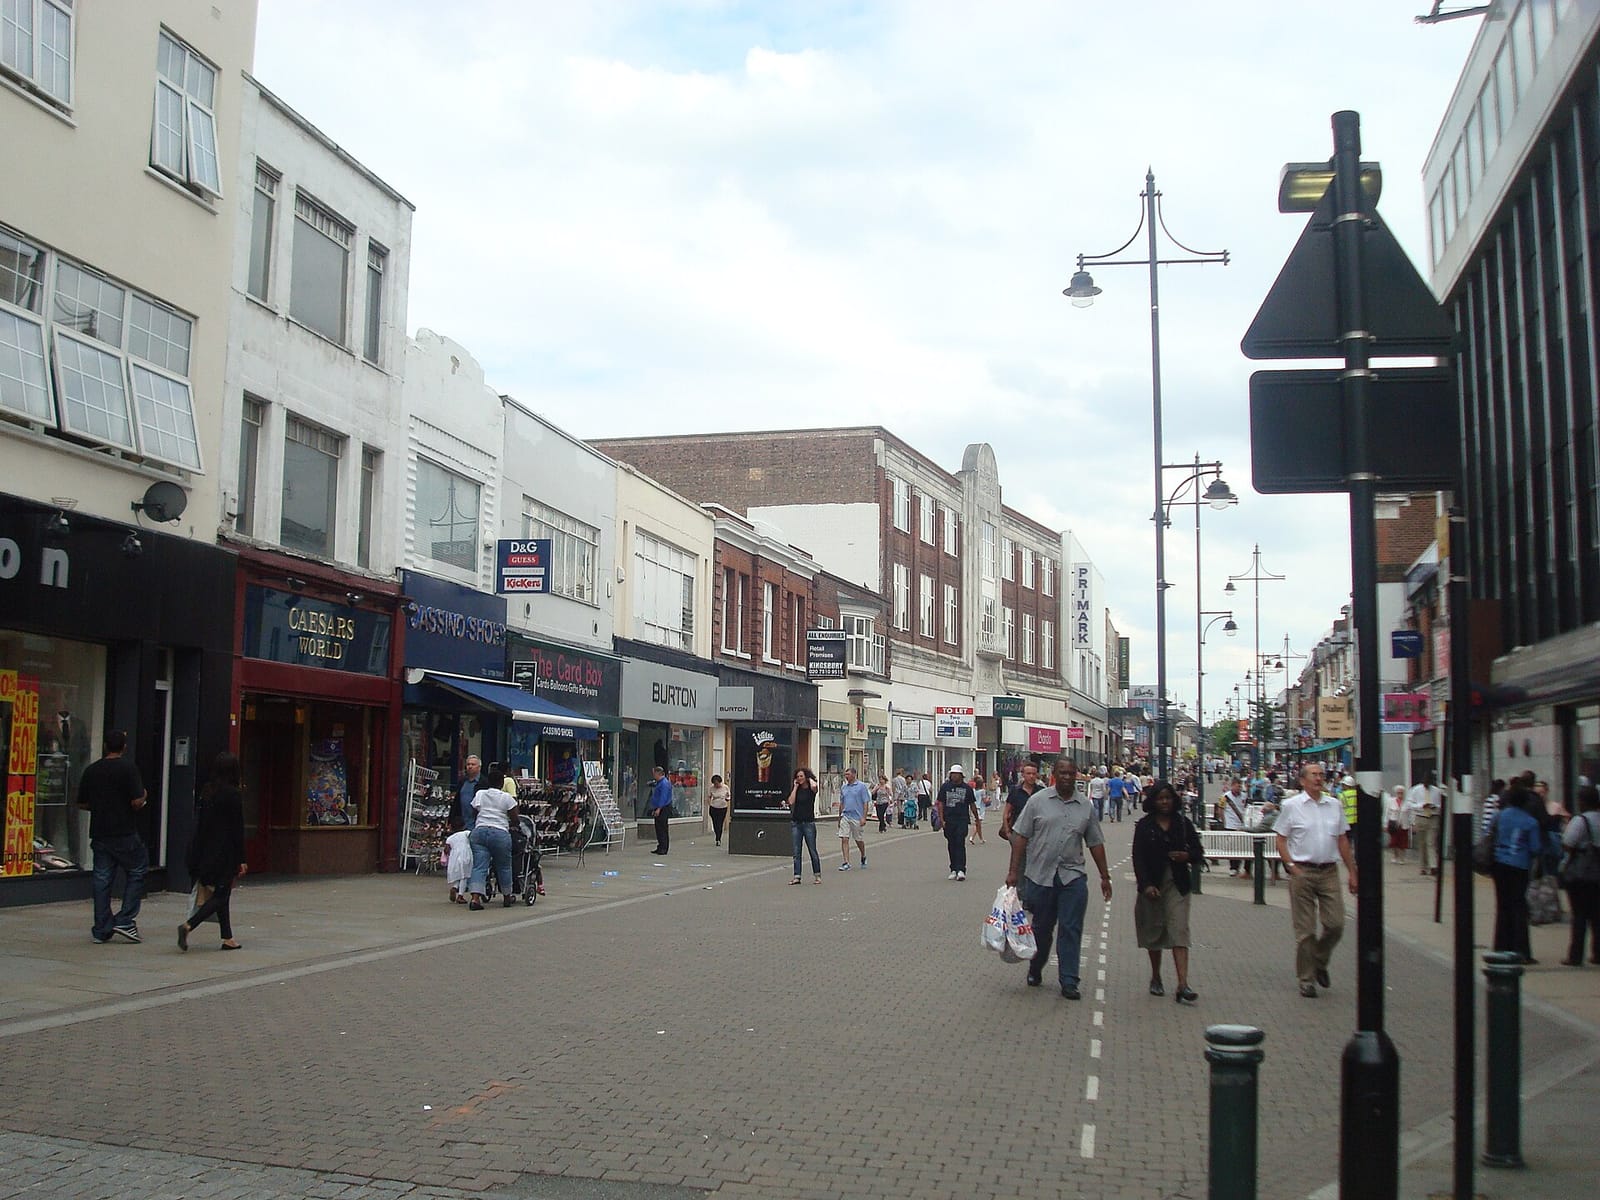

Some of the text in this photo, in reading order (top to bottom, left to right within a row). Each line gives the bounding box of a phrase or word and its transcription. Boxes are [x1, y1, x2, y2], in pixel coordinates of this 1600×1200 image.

[511, 541, 537, 553] D&G
[511, 556, 536, 564] GUESS
[1077, 568, 1089, 643] PRIMARK
[288, 607, 355, 640] CAESARS
[299, 636, 343, 660] WORLD
[531, 648, 603, 687] The Card Box
[15, 694, 37, 724] SALE
[652, 682, 697, 709] BURTON
[542, 726, 560, 736] CASSINO
[8, 796, 33, 826] SALE
